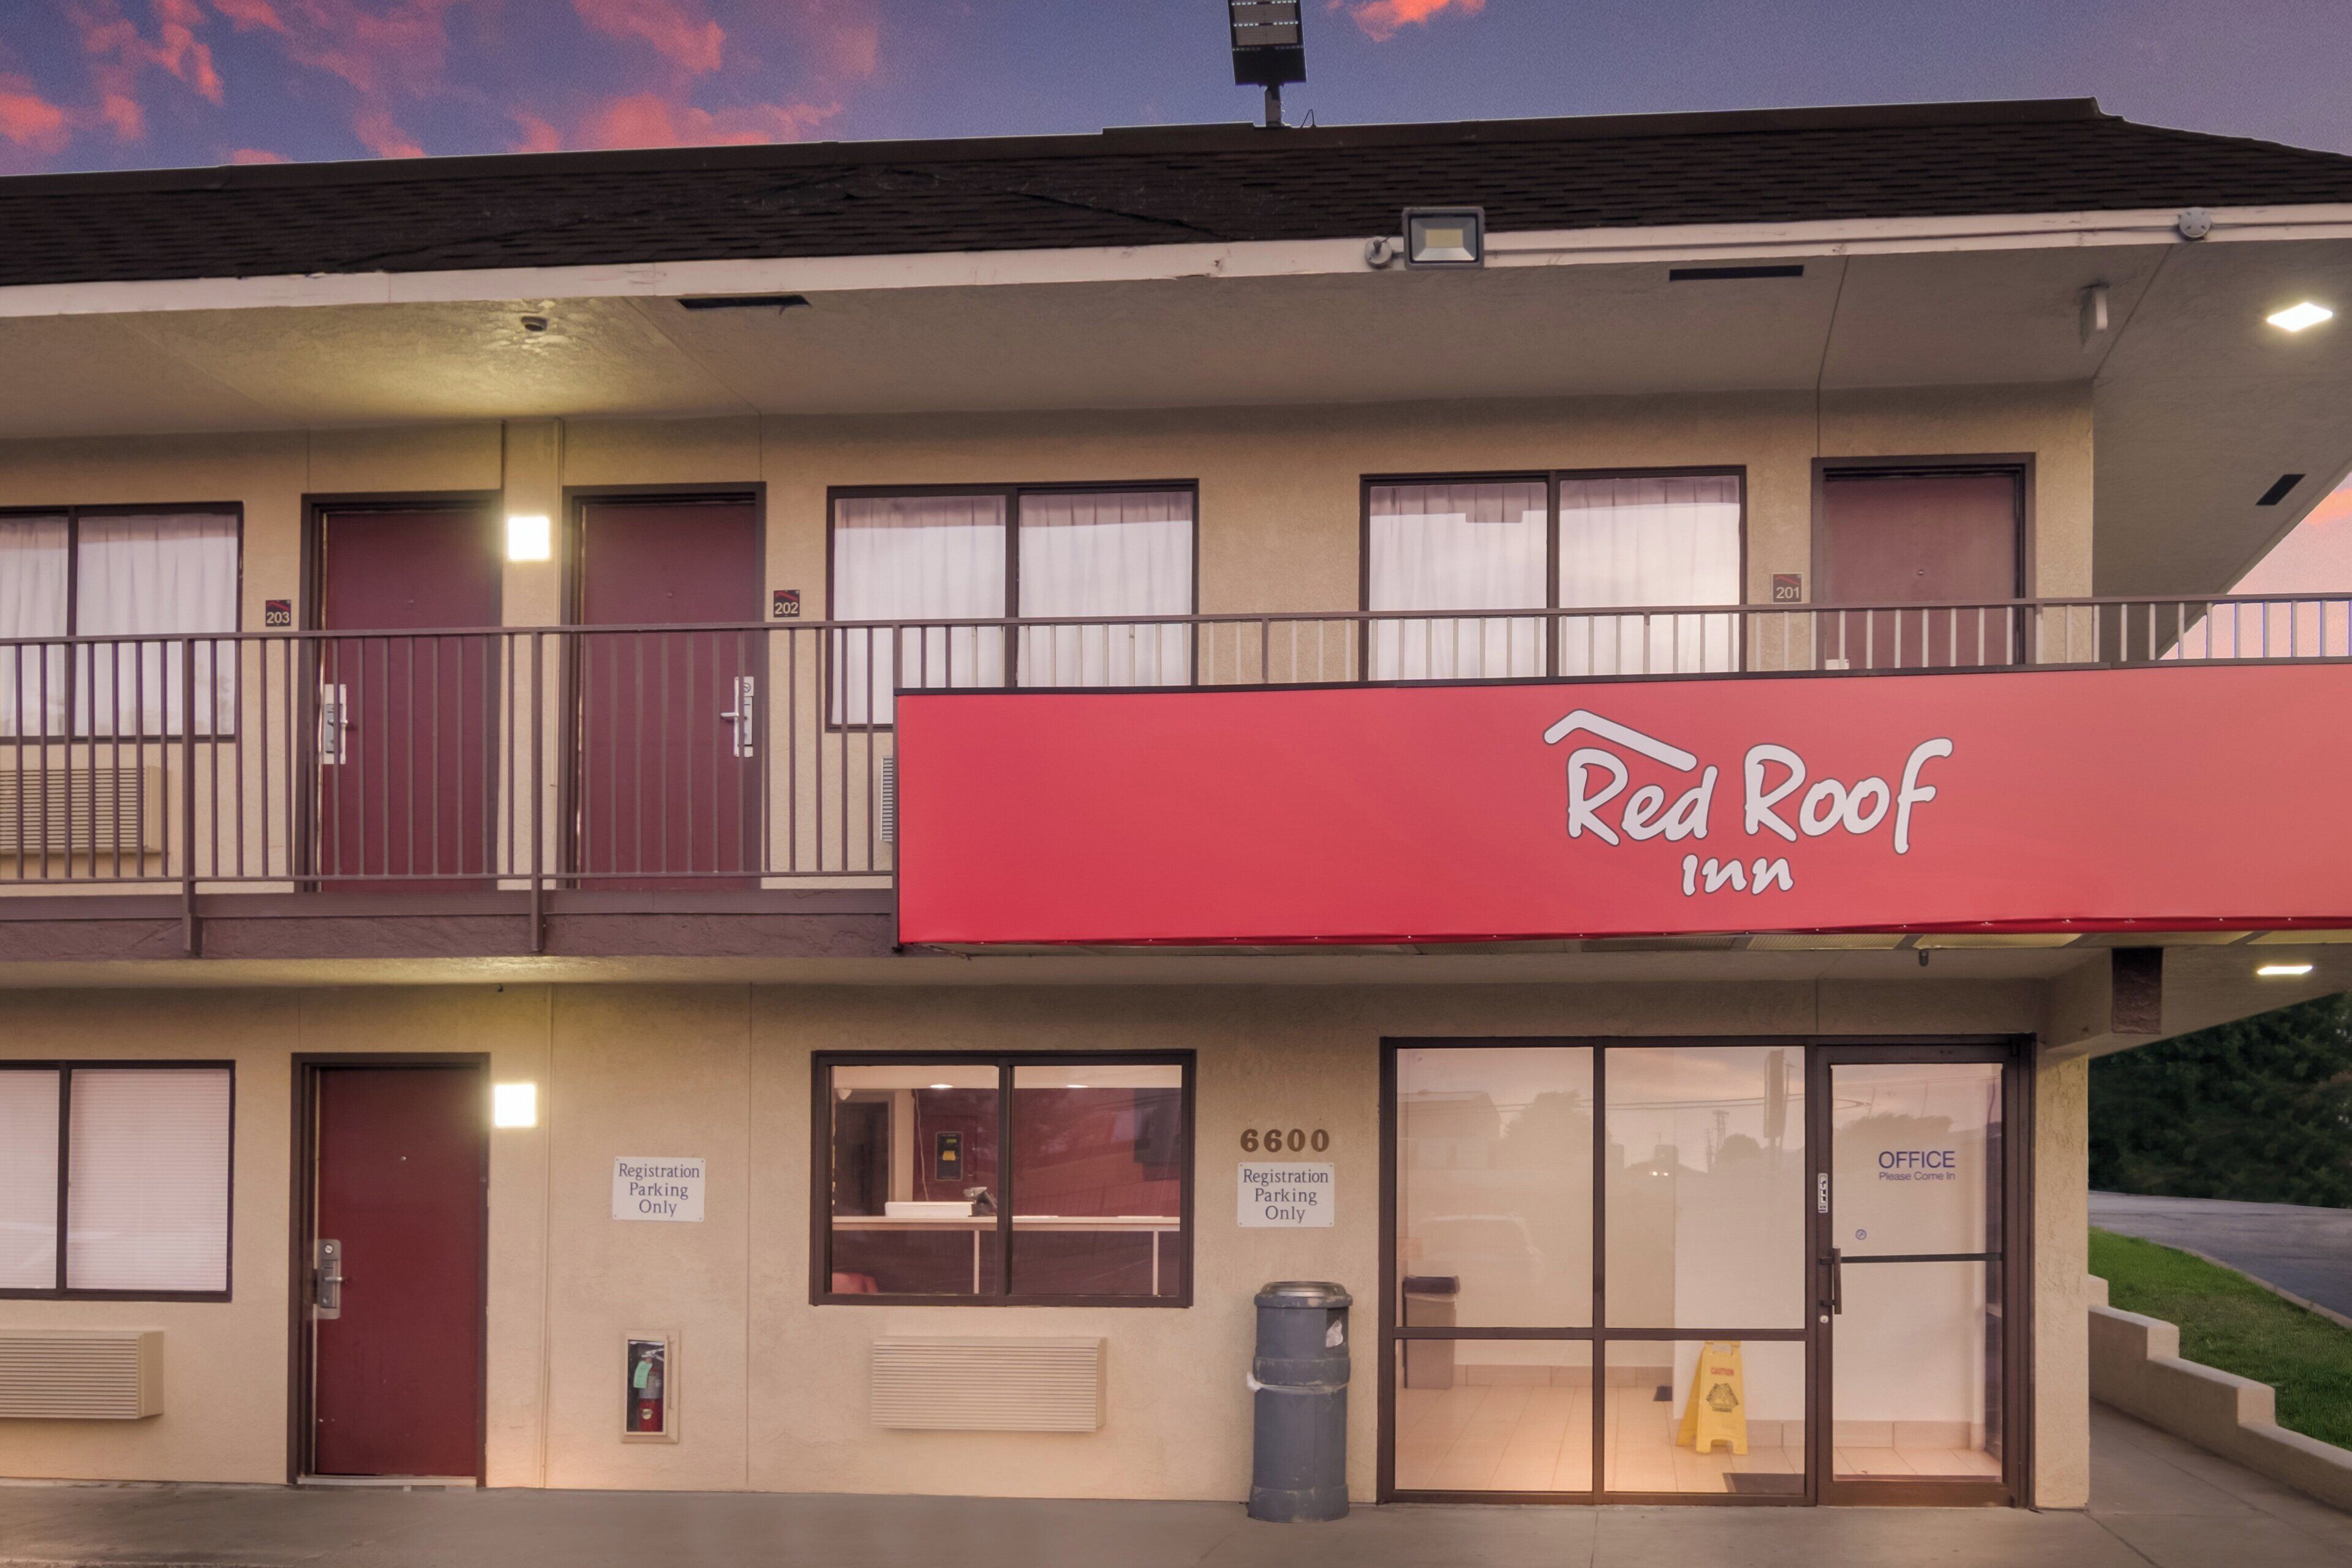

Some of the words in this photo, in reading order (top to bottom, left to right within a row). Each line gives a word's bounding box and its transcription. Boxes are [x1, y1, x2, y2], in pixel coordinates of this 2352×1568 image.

[1776, 586, 1800, 599] 201
[775, 601, 798, 614] 202
[266, 611, 290, 624] 203
[1567, 747, 1719, 846] Red
[1744, 737, 1954, 854] Roof
[1240, 1128, 1330, 1153] 6600
[1879, 1150, 1956, 1169] OFFICE
[619, 1163, 700, 1181] Registration
[1243, 1169, 1329, 1186] Registration
[1879, 1172, 1912, 1180] Please
[1913, 1171, 1944, 1180] Come
[629, 1182, 688, 1200] Parking
[1255, 1188, 1317, 1206] Parking
[639, 1199, 677, 1218] Only
[1265, 1205, 1305, 1224] Only
